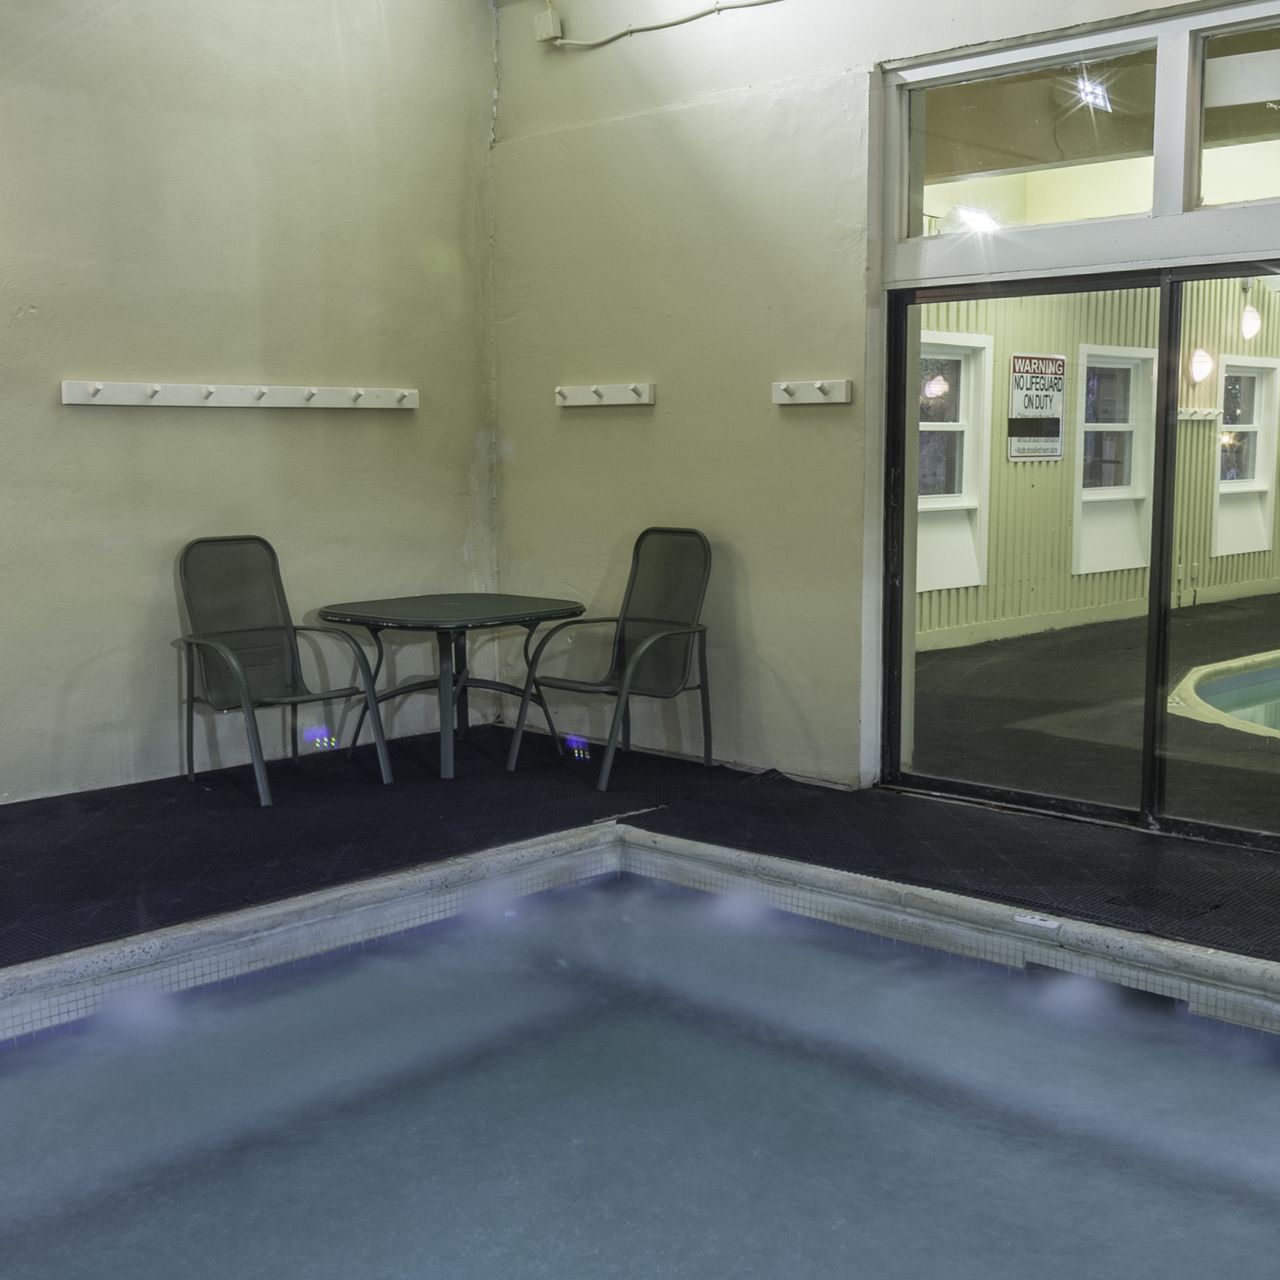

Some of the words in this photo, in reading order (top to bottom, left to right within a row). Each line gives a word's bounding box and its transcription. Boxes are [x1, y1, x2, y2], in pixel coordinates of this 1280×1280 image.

[1015, 358, 1064, 374] WARNING
[1014, 375, 1025, 391] NO
[1026, 375, 1063, 392] LIFEGUARD
[1024, 394, 1034, 410] ON
[1035, 394, 1054, 410] DUTY
